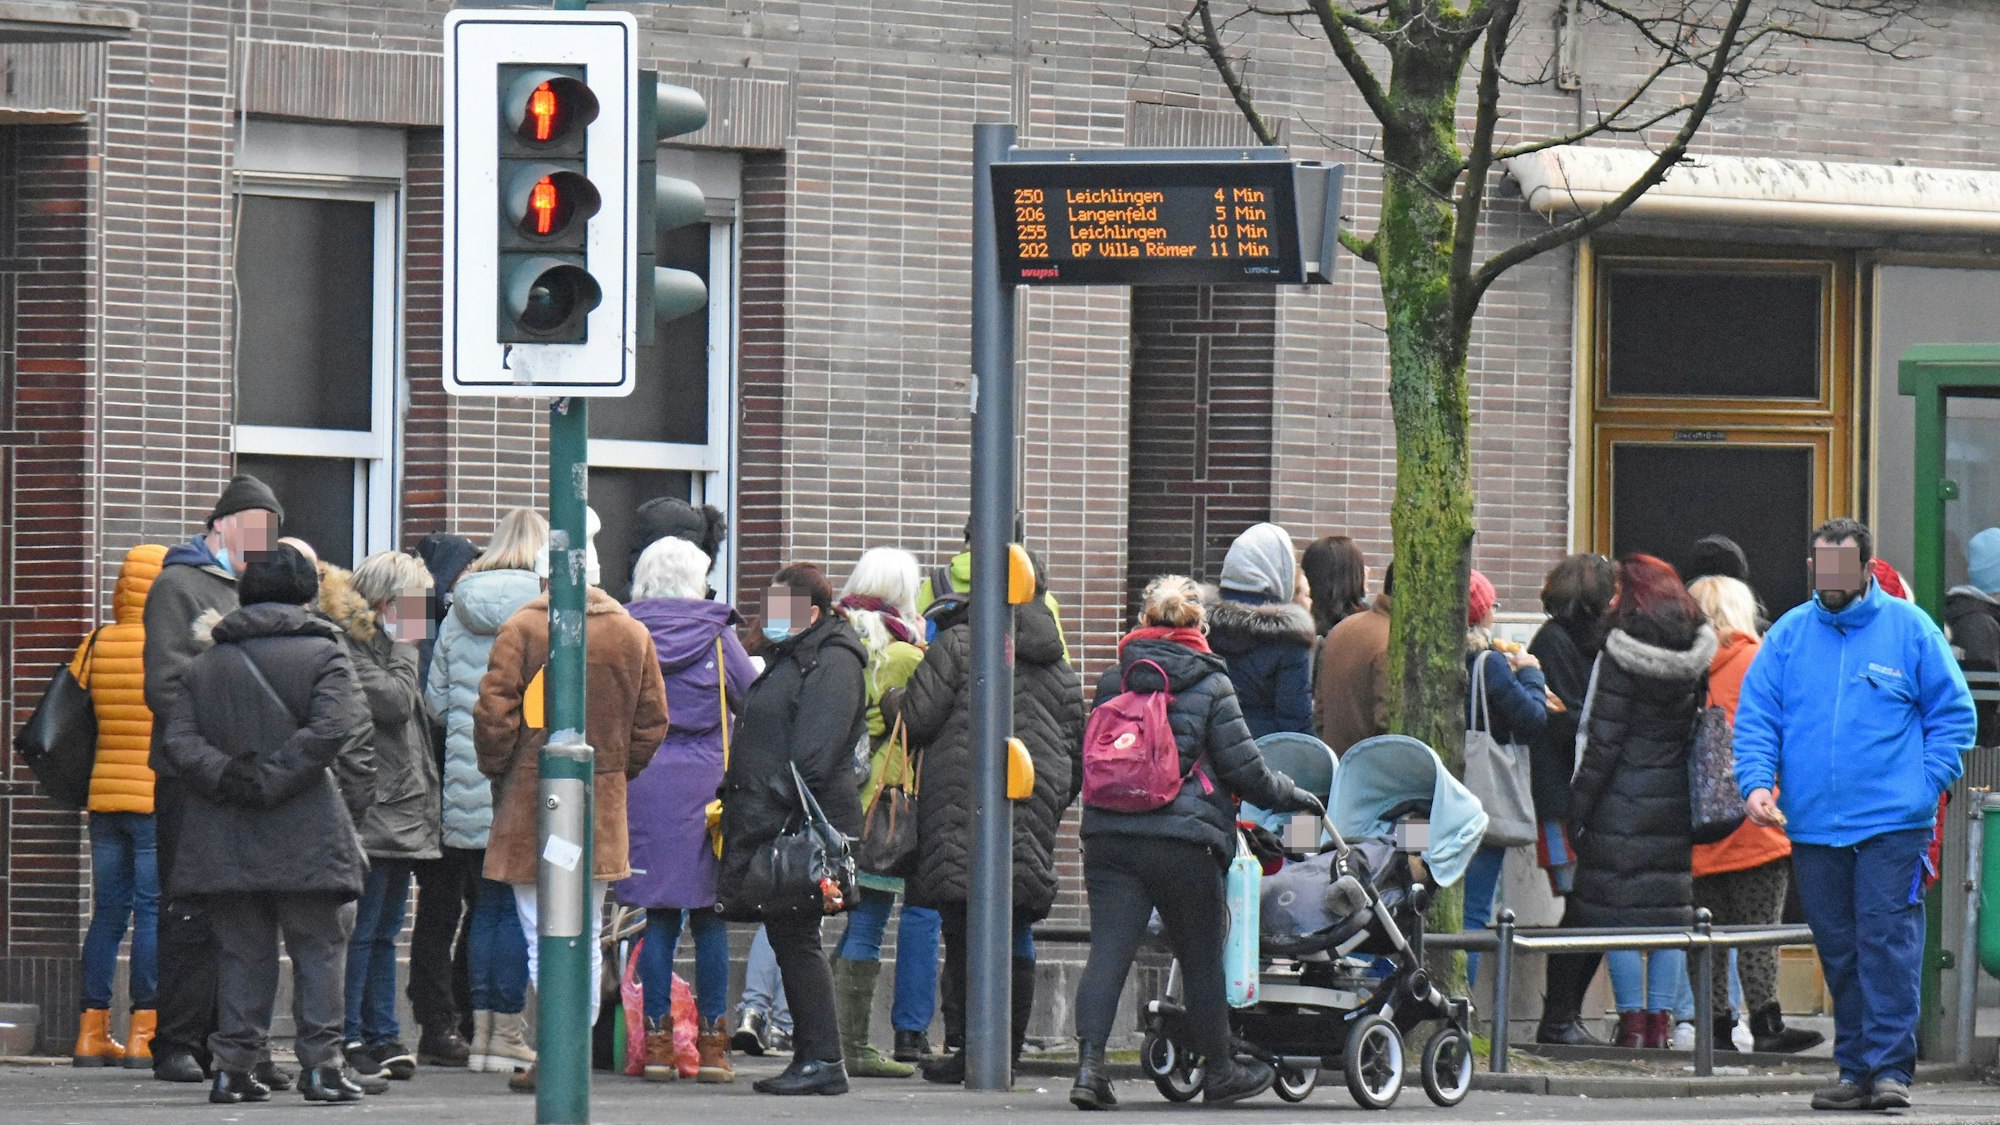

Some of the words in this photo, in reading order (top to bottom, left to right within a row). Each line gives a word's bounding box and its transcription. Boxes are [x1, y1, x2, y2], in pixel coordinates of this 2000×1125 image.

[1014, 188, 1043, 204] 250
[1066, 188, 1164, 206] Leichlingen
[1214, 188, 1225, 203] 4
[1233, 187, 1264, 203] Min
[1015, 206, 1045, 222] 206
[1068, 206, 1157, 224] Langenfeld
[1215, 205, 1227, 221] 5
[1235, 205, 1266, 221] Min
[1017, 224, 1047, 240] 255
[1069, 224, 1167, 242] Leichlingen
[1209, 223, 1228, 239] 10
[1237, 223, 1267, 239] Min
[1018, 242, 1049, 258] 202
[1071, 242, 1092, 258] OP
[1099, 242, 1139, 258] Villa
[1145, 241, 1197, 257] Römer
[1211, 241, 1228, 257] 11
[1238, 241, 1270, 257] Min
[1021, 264, 1059, 279] wupsi
